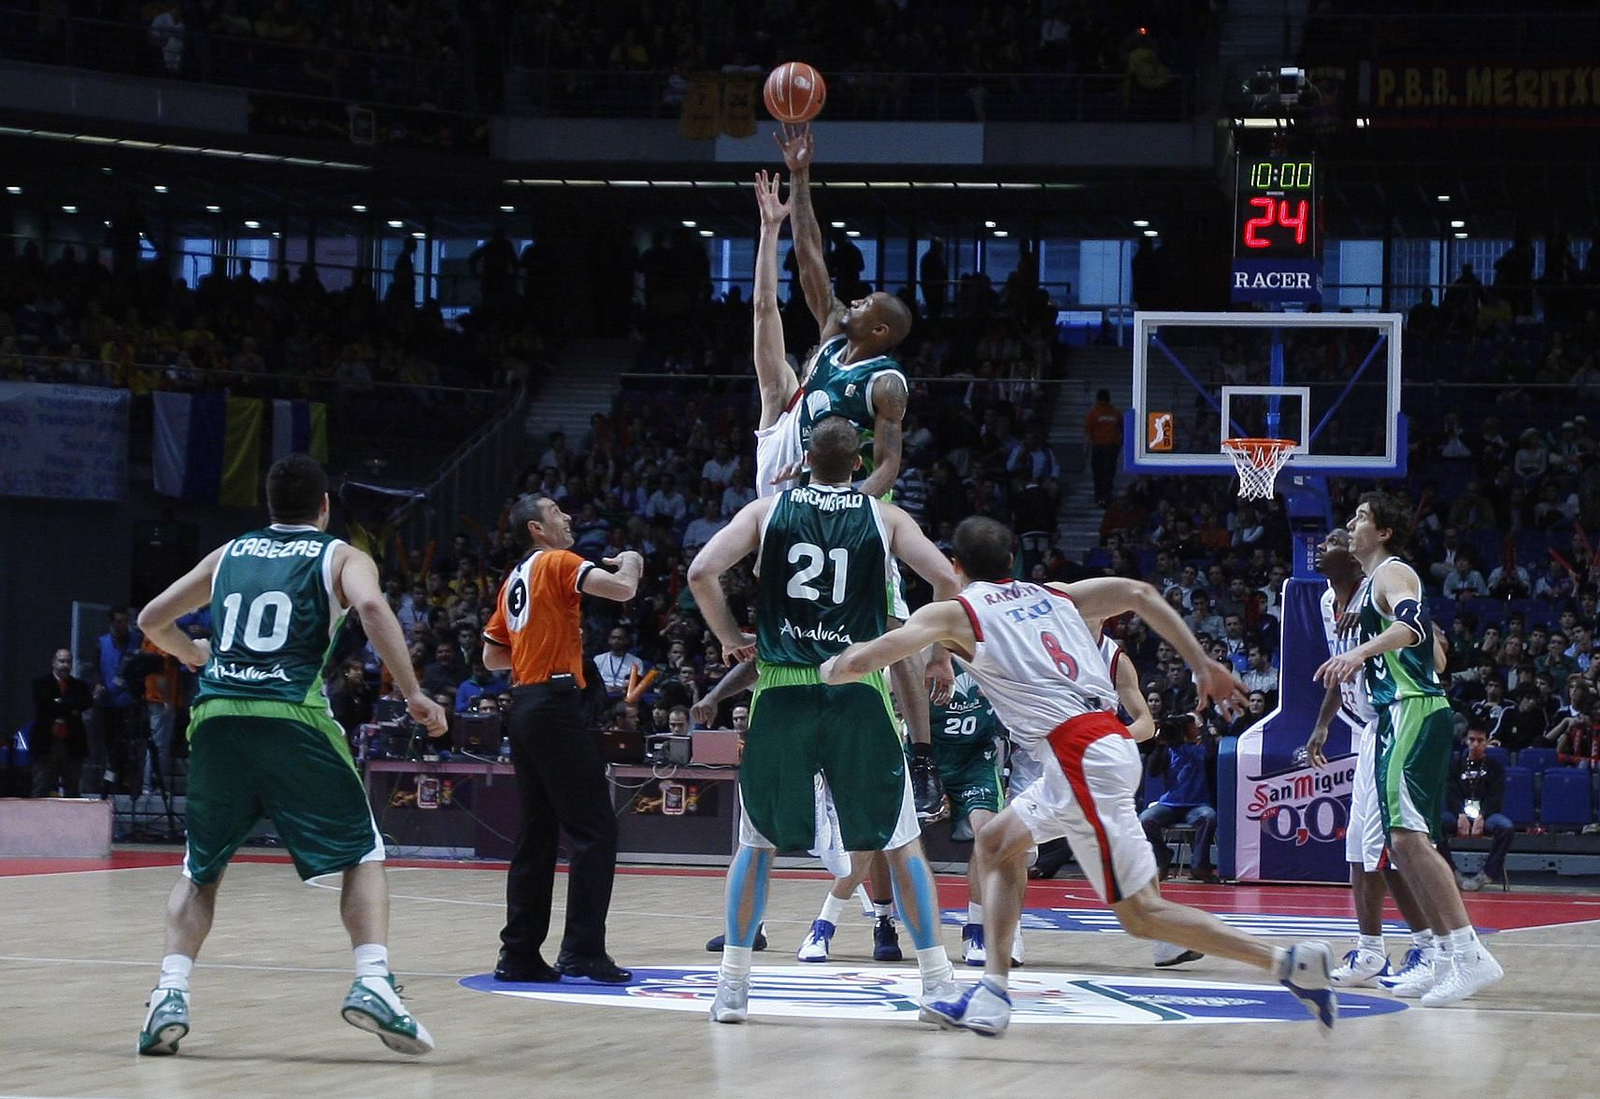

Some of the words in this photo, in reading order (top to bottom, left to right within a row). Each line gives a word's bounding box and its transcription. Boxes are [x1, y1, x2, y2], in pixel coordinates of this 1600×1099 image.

[1250, 162, 1312, 188] 10:00
[1243, 196, 1309, 249] 24
[1233, 271, 1312, 289] RACER
[1163, 421, 1171, 446] ACB
[790, 488, 863, 511] ARCHIBALD
[230, 538, 323, 559] CABEZAS
[786, 542, 848, 605] 21
[219, 590, 293, 652] 10
[1040, 631, 1078, 682] 8
[944, 716, 977, 735] 20
[1248, 783, 1293, 812] San
[1285, 768, 1355, 800] Migue
